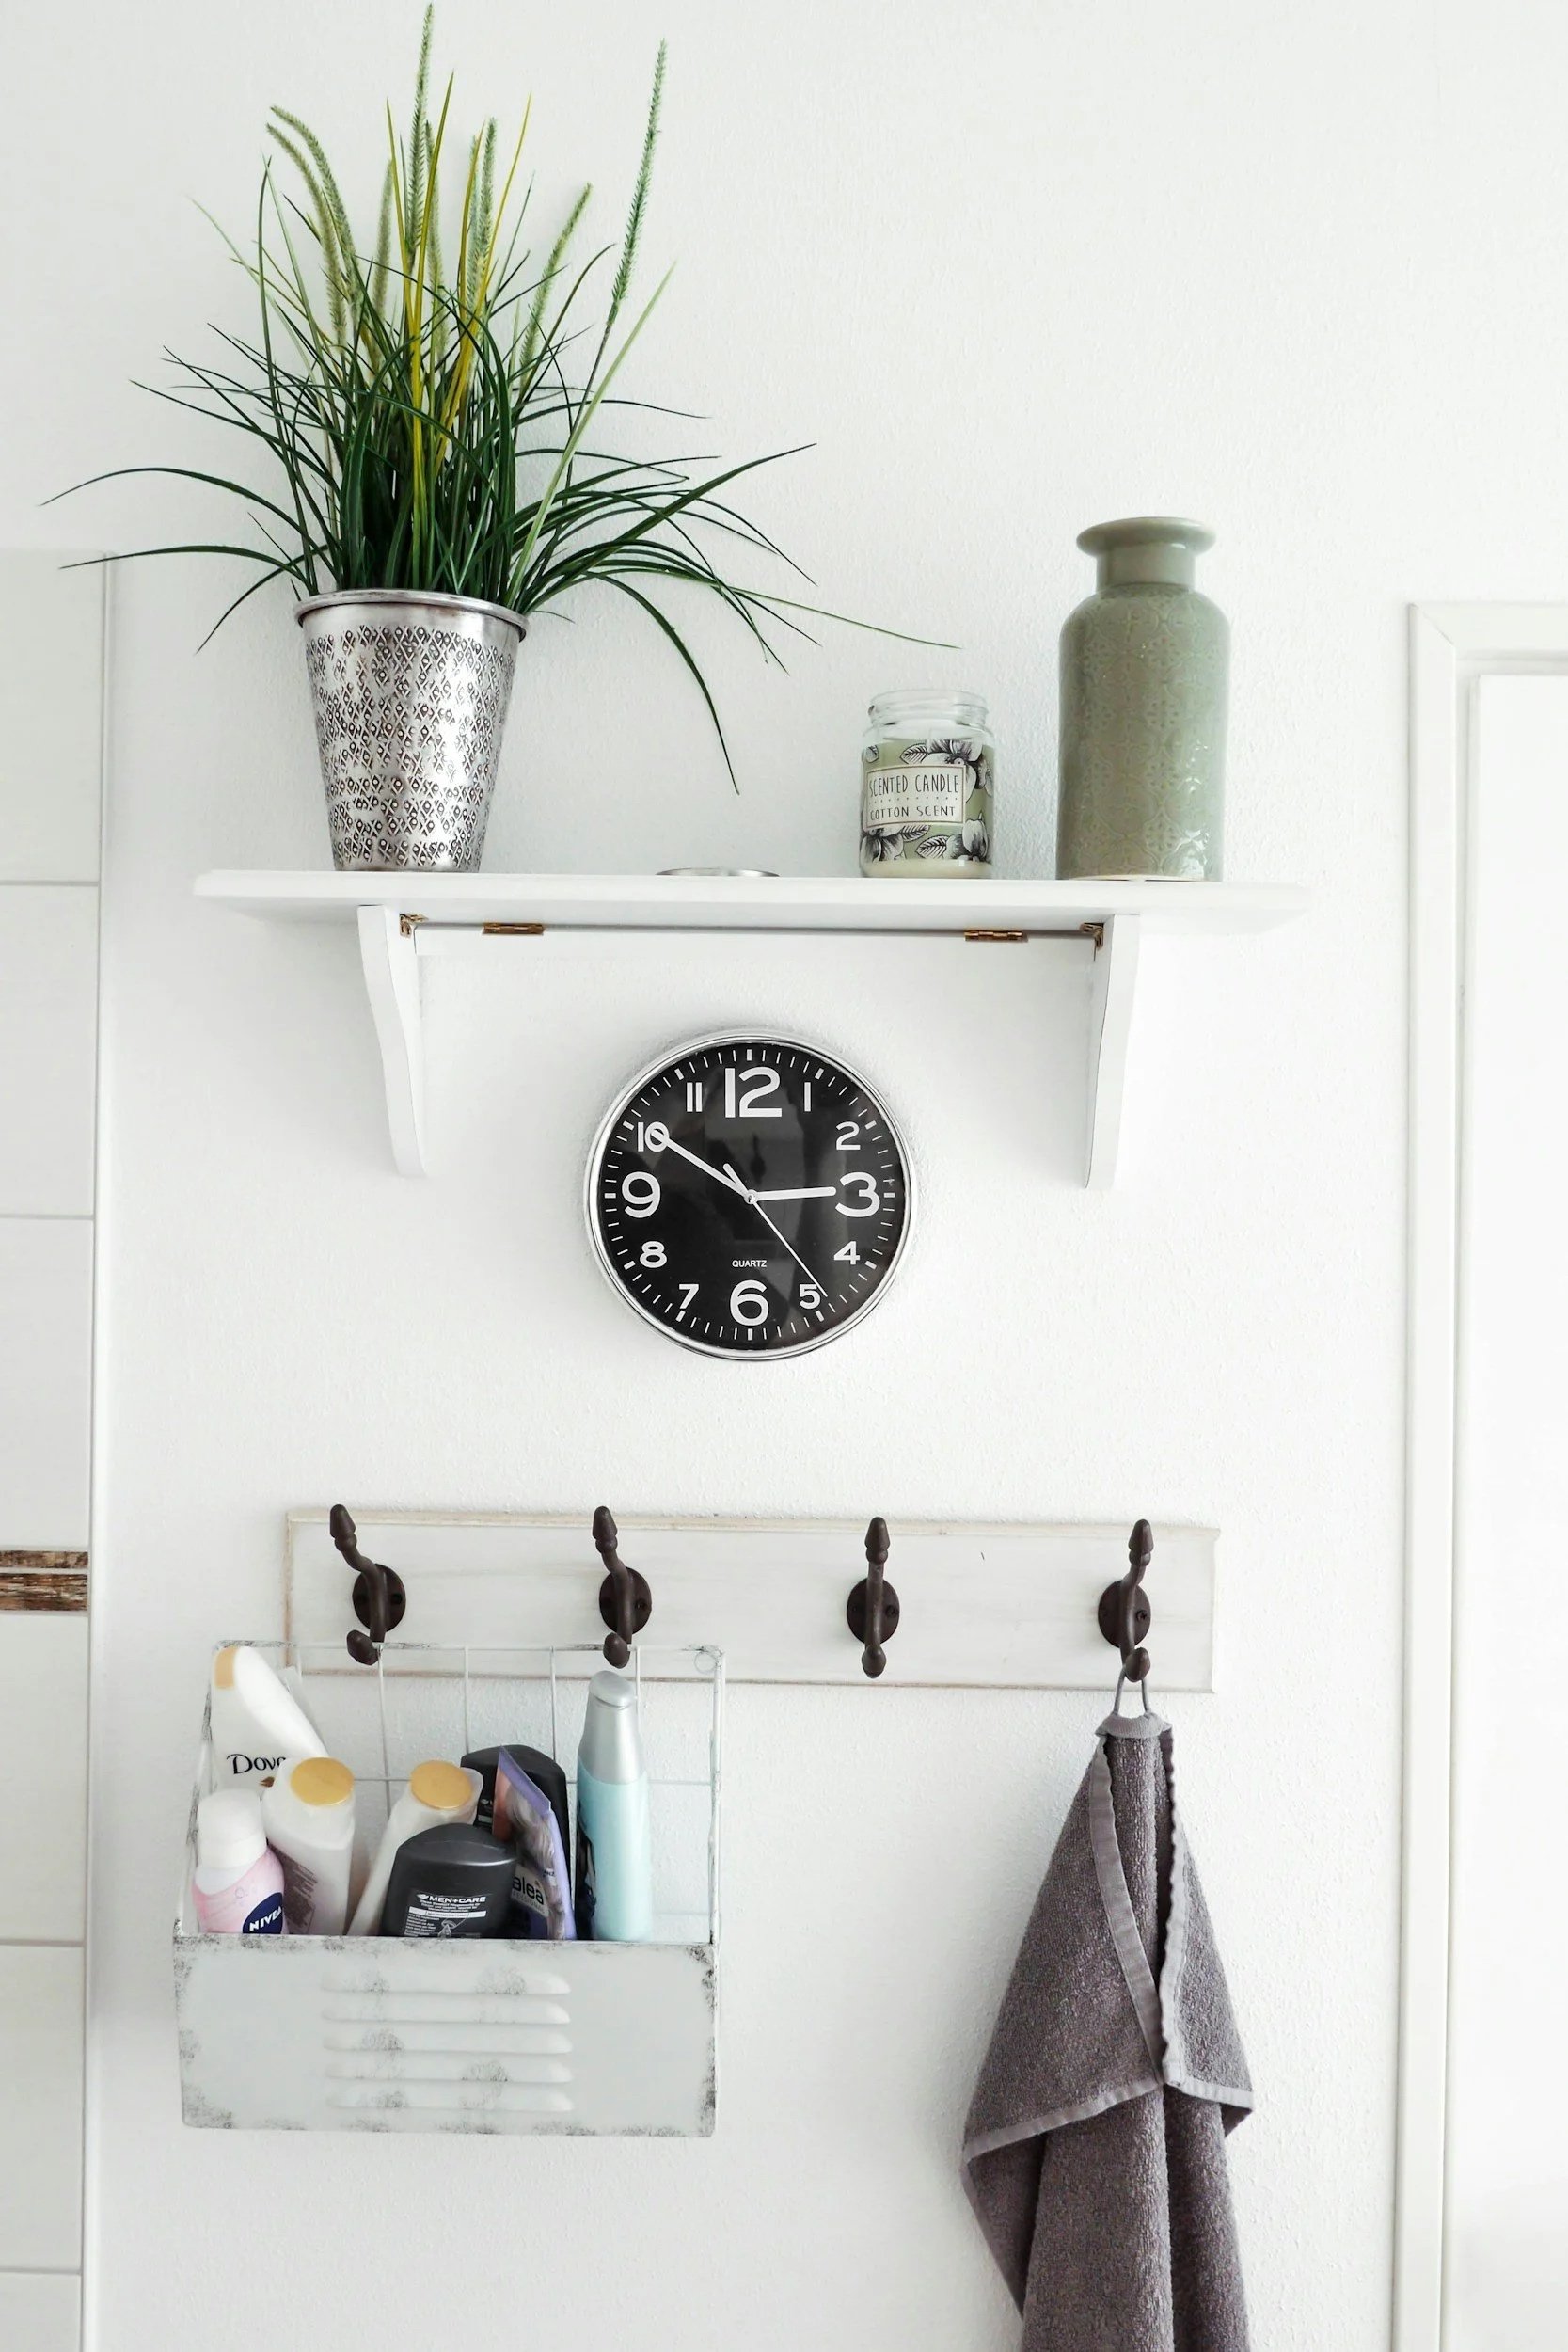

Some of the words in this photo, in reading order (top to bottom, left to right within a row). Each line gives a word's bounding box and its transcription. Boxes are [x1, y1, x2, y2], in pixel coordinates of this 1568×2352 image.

[869, 774, 908, 798] SCENTED
[915, 774, 958, 793] CANDLE
[870, 806, 909, 821] COTTON
[916, 805, 955, 817] SCENT
[686, 1082, 703, 1113] 11
[724, 1066, 783, 1119] 12
[803, 1081, 812, 1113] 1
[637, 1121, 670, 1152] 10
[835, 1120, 861, 1151] 2
[621, 1171, 661, 1218] 9
[834, 1171, 880, 1218] 3
[639, 1240, 668, 1268] 8
[732, 1259, 768, 1268] QUARTZ
[833, 1240, 861, 1265] 4
[678, 1283, 700, 1310] 7
[730, 1279, 769, 1327] 6
[799, 1283, 821, 1310] 5
[429, 1895, 486, 1904] MEN+CARE
[512, 1876, 545, 1905] alea
